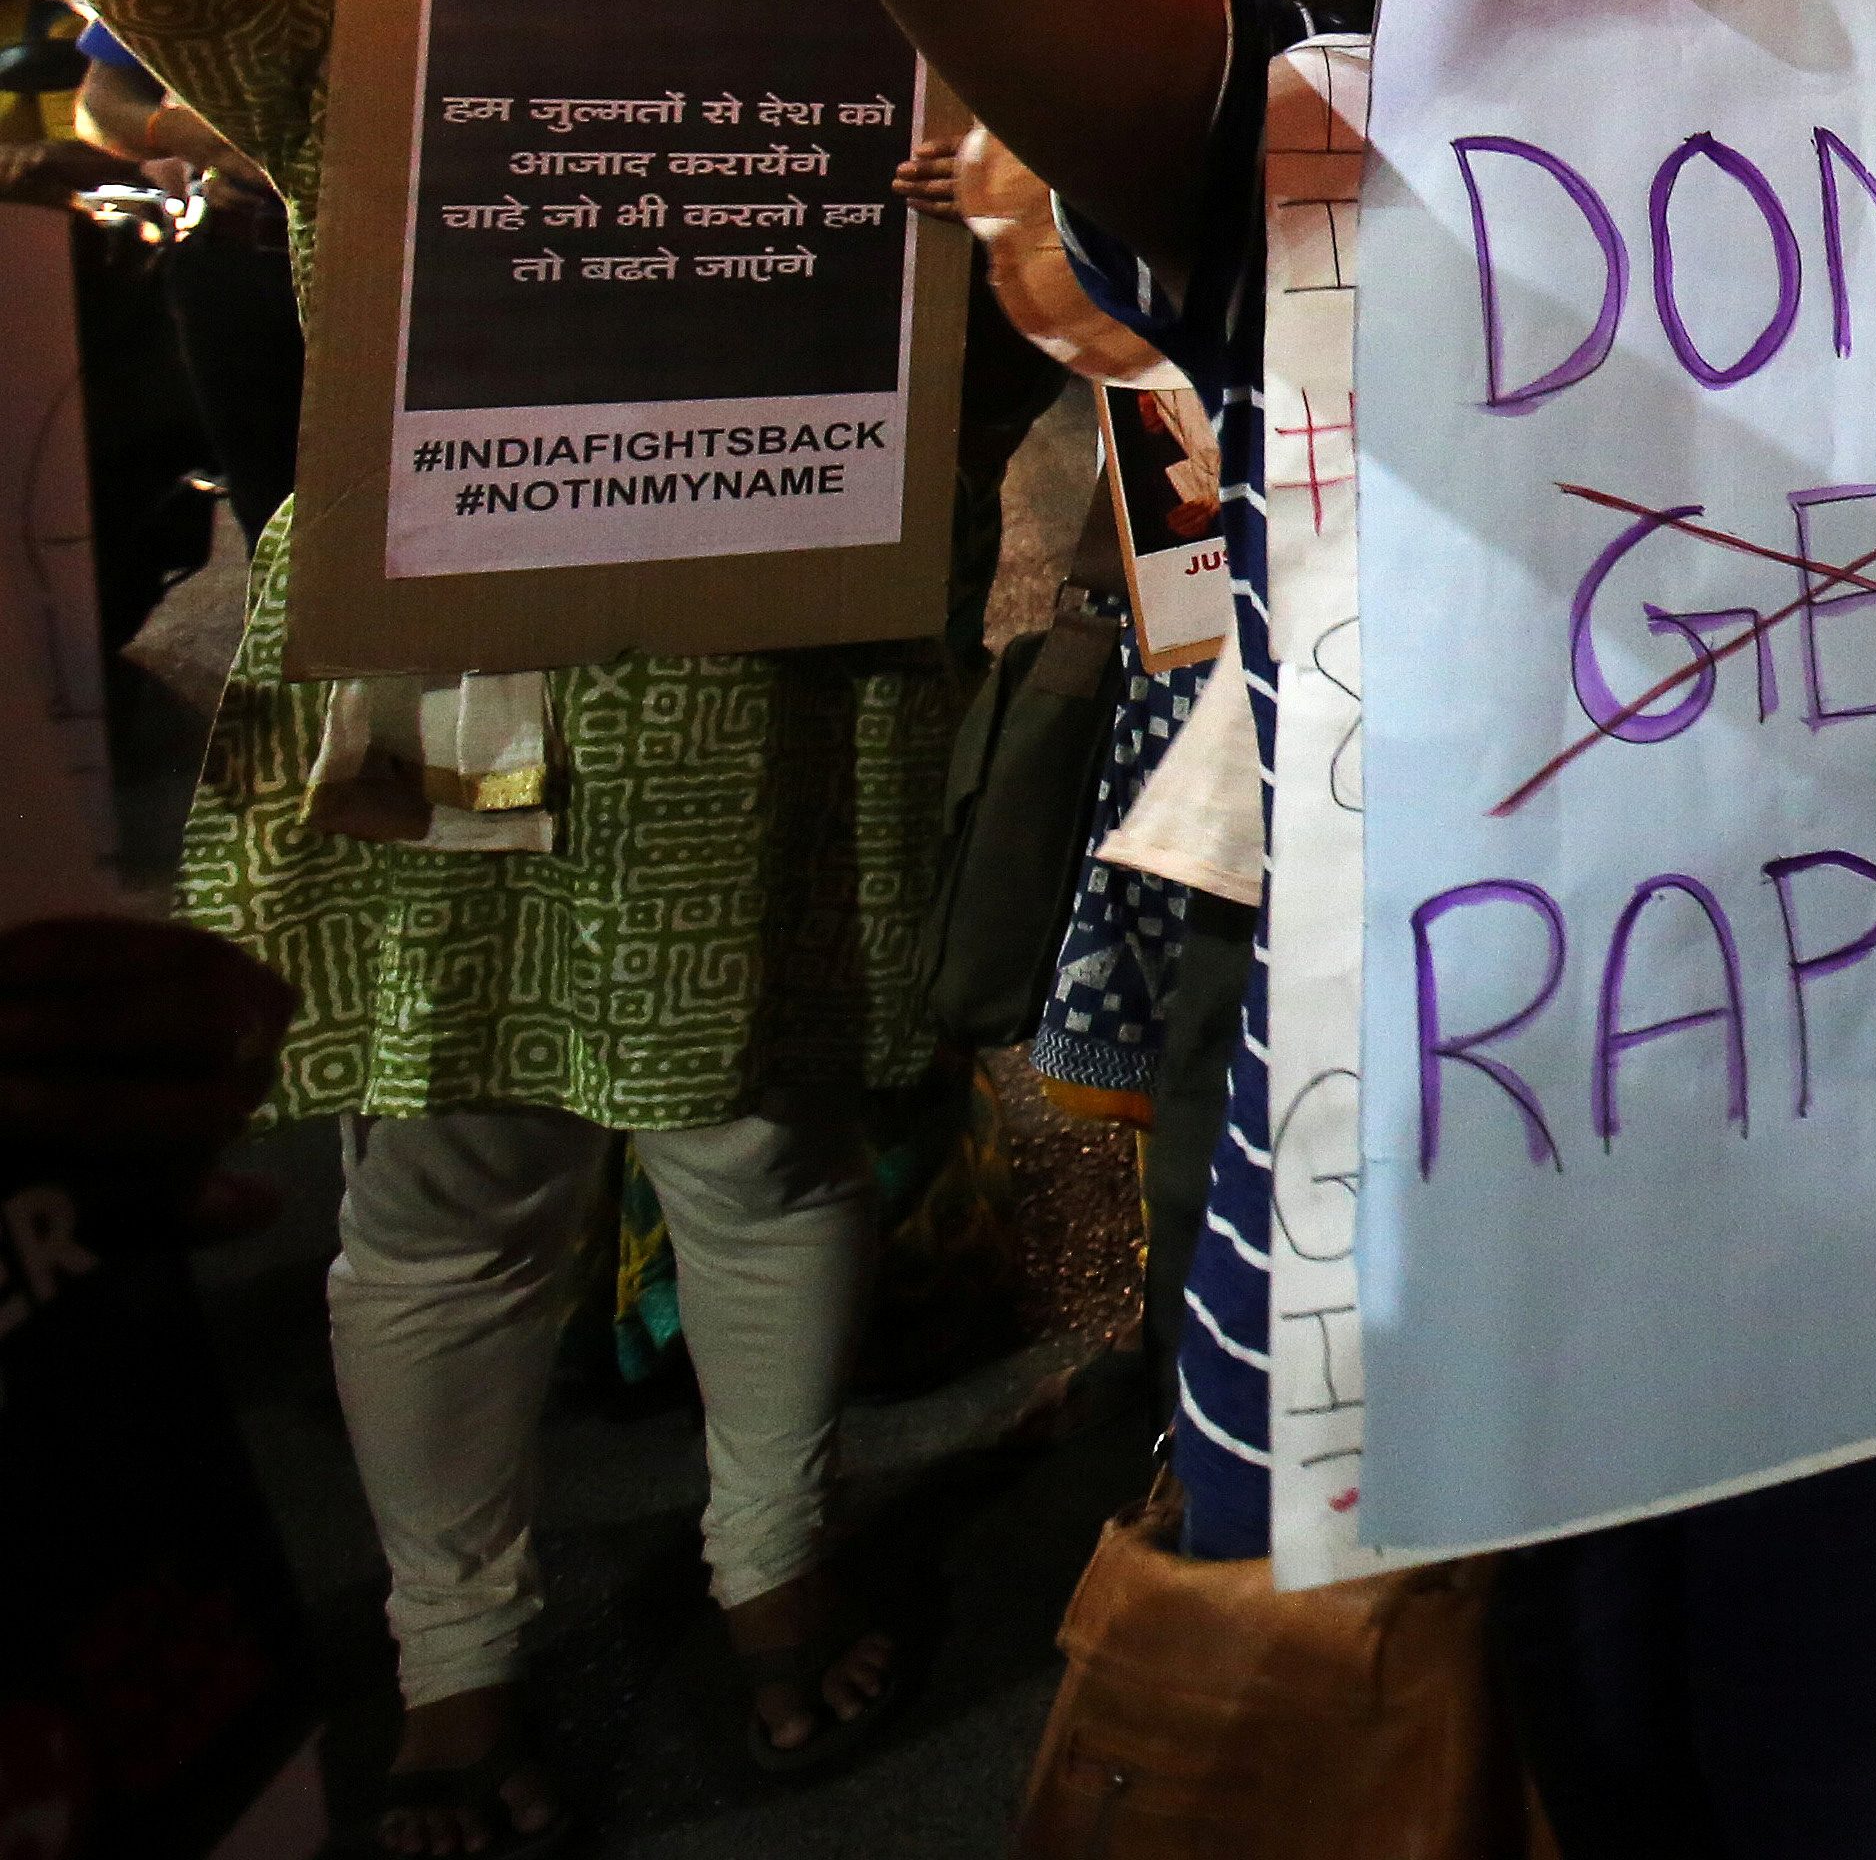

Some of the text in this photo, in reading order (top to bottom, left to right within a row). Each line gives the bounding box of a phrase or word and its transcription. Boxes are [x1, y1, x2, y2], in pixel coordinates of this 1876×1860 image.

[442, 91, 895, 132] हम जुल्मतों से देश को
[509, 151, 656, 177] आजाद
[442, 193, 885, 230] चाहे जो भी करलो हम
[512, 248, 565, 282] तो
[694, 245, 817, 282] जाएंगे
[413, 420, 886, 473] #INDIAFIGHTSBACK
[455, 464, 845, 516] #NOTINMYNAME
